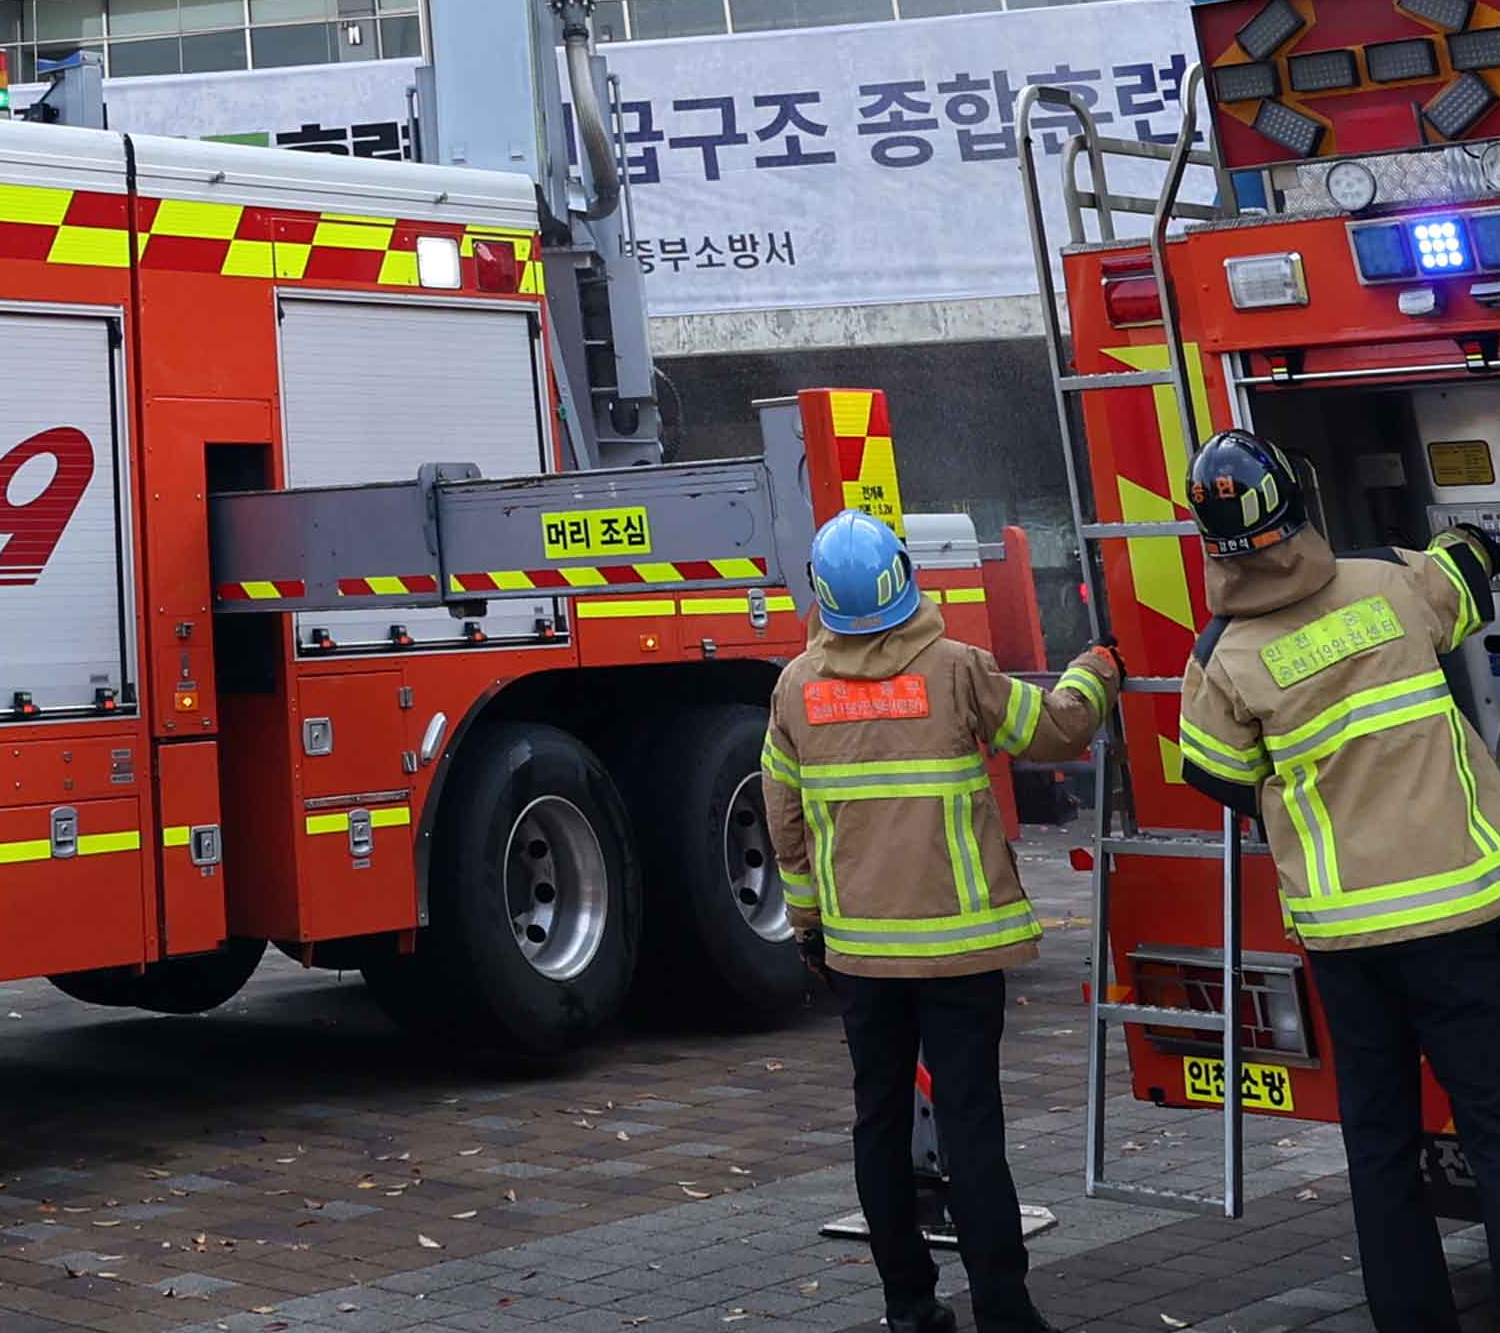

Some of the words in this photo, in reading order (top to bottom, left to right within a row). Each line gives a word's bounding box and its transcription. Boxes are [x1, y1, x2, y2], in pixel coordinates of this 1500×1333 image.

[562, 91, 836, 185] 급구조
[546, 518, 590, 549] 머리
[600, 515, 646, 546] 조심
